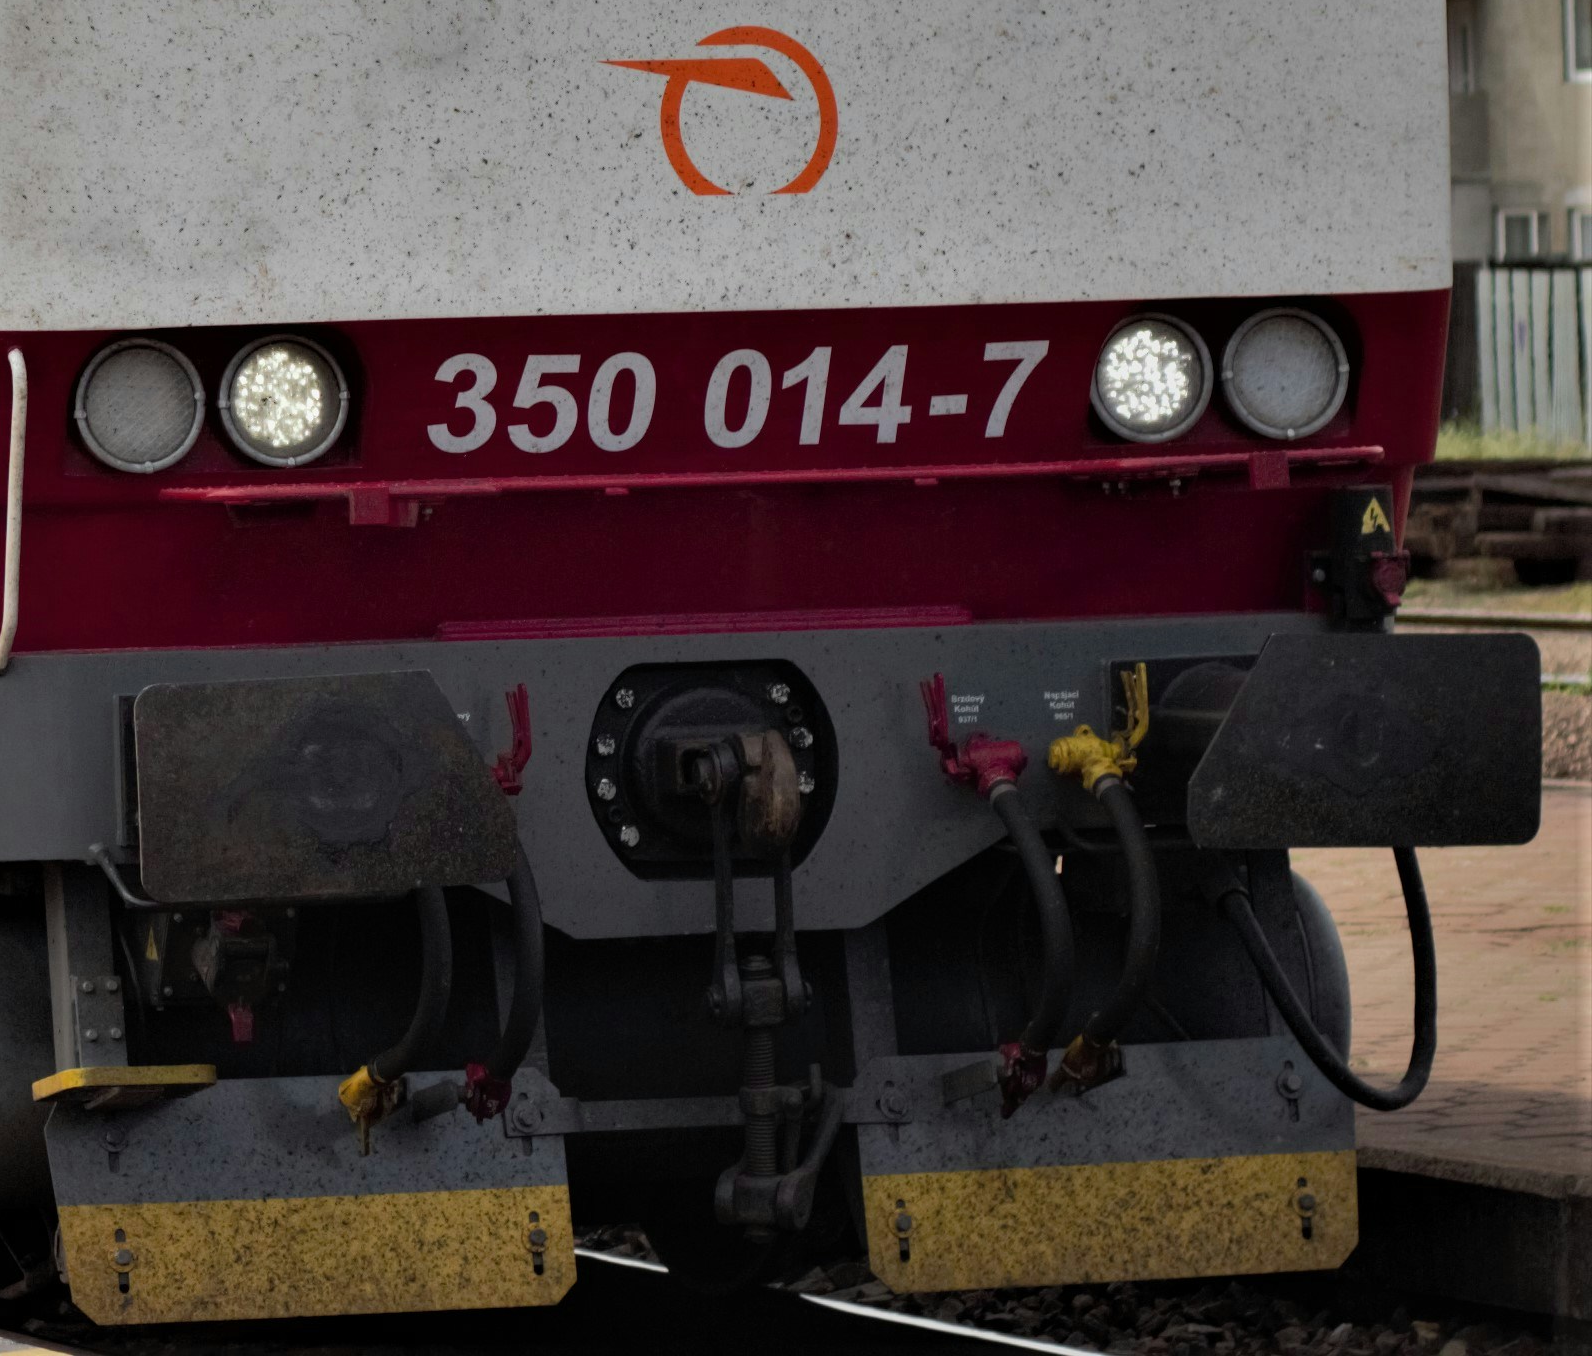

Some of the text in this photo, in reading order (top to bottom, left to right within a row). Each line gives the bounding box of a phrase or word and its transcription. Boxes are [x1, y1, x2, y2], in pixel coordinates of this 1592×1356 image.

[427, 339, 1050, 454] 350 014-7
[951, 694, 985, 704] Brzdový
